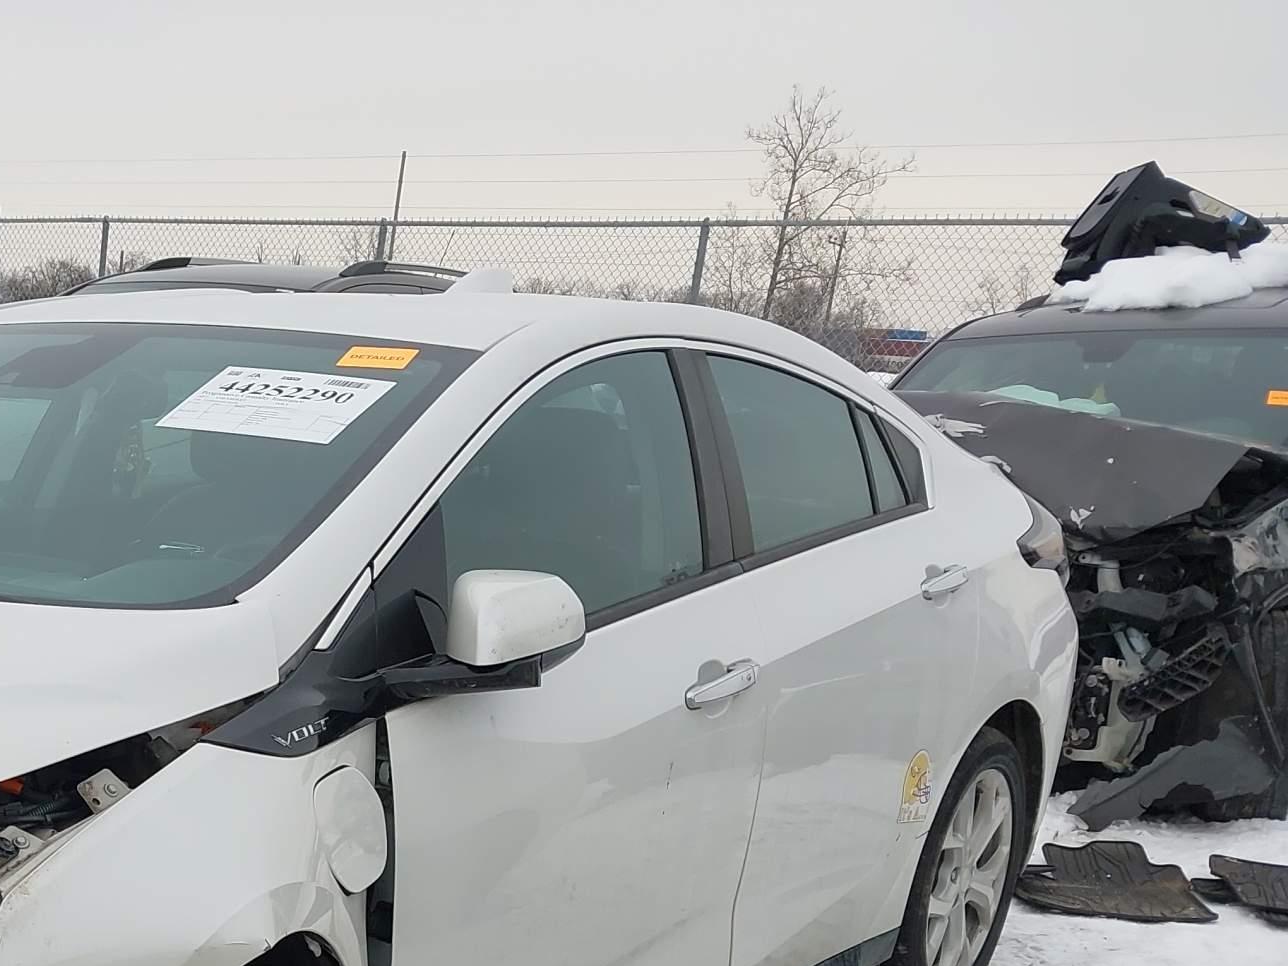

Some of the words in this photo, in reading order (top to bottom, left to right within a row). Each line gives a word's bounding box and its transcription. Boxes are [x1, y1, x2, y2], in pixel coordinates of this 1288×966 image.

[349, 353, 405, 362] DETAILED
[218, 380, 355, 404] 44252290
[270, 716, 330, 748] VOLT
